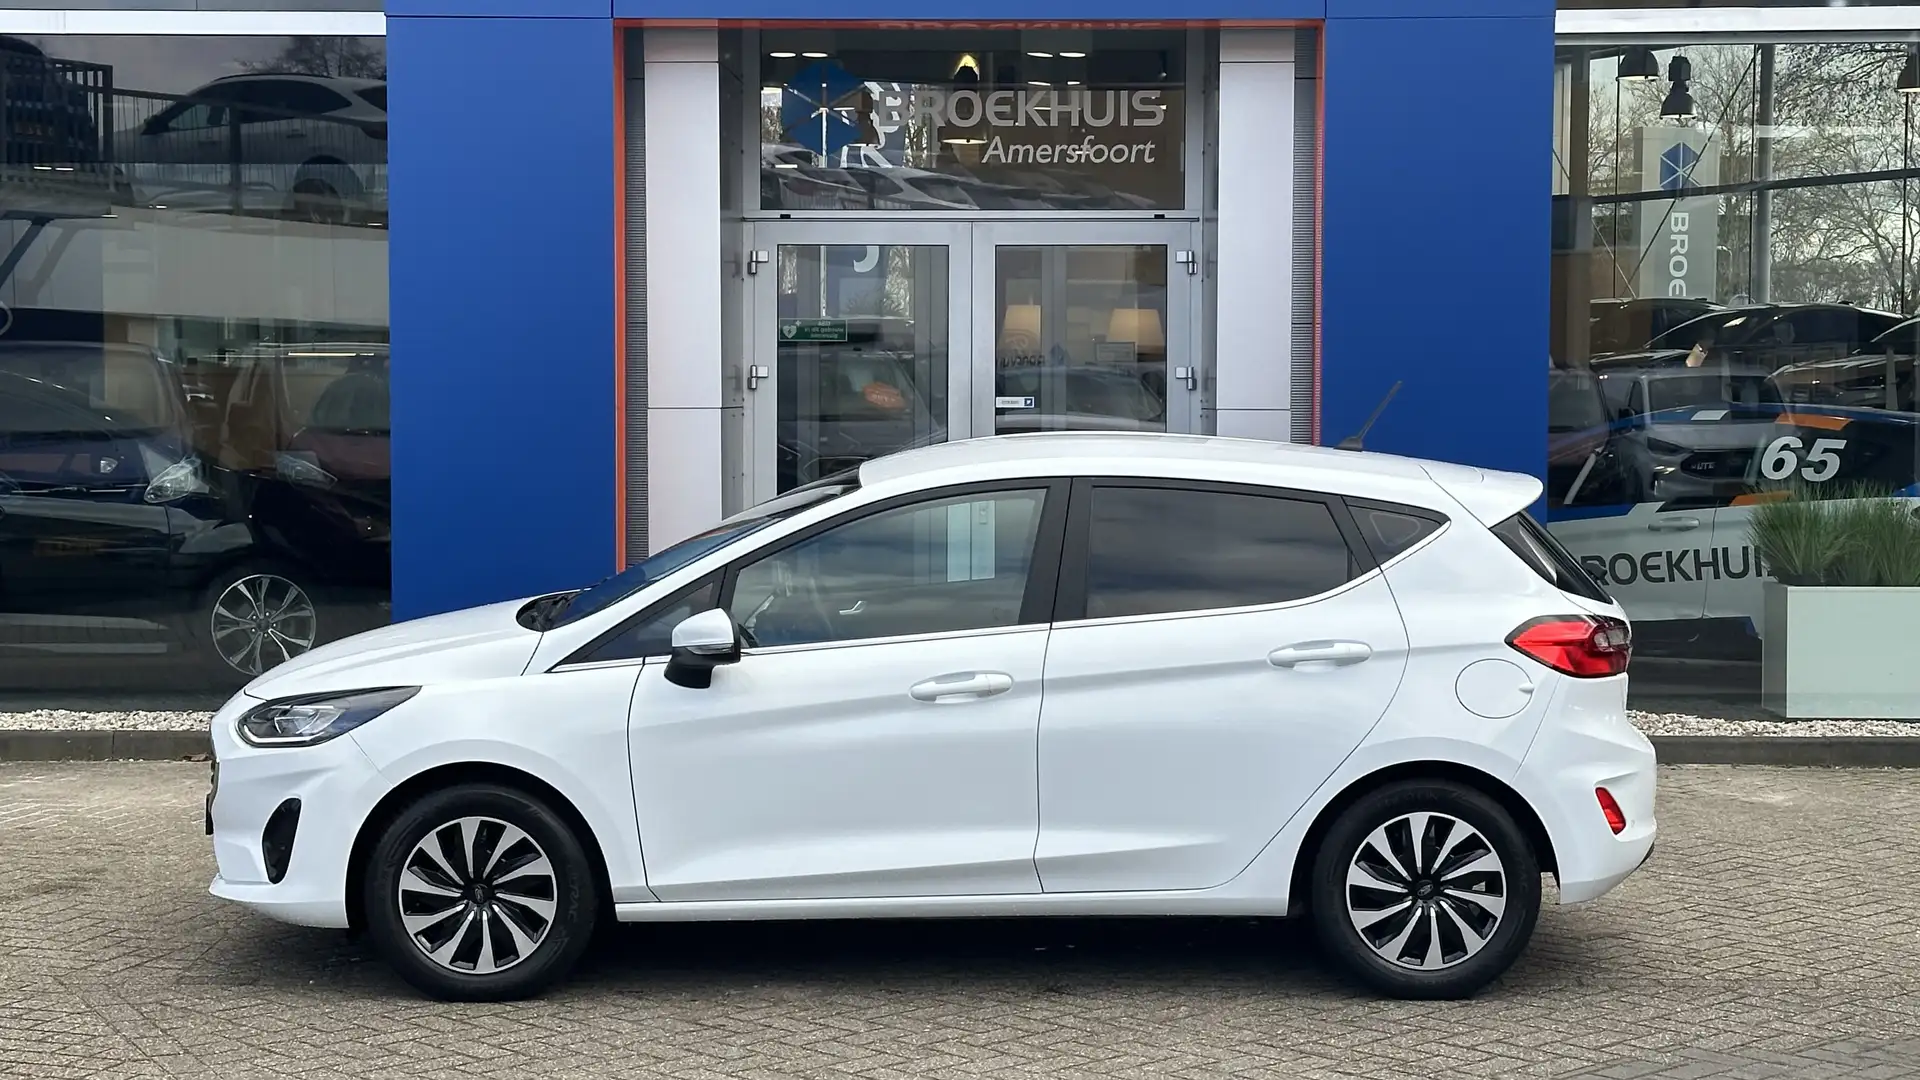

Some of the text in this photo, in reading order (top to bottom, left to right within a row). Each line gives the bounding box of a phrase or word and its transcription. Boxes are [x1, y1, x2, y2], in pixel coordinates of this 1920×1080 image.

[878, 90, 1164, 127] BROEKHUIS
[982, 135, 1155, 164] Amersfoort
[1669, 212, 1690, 297] BROE
[1761, 436, 1847, 482] 65
